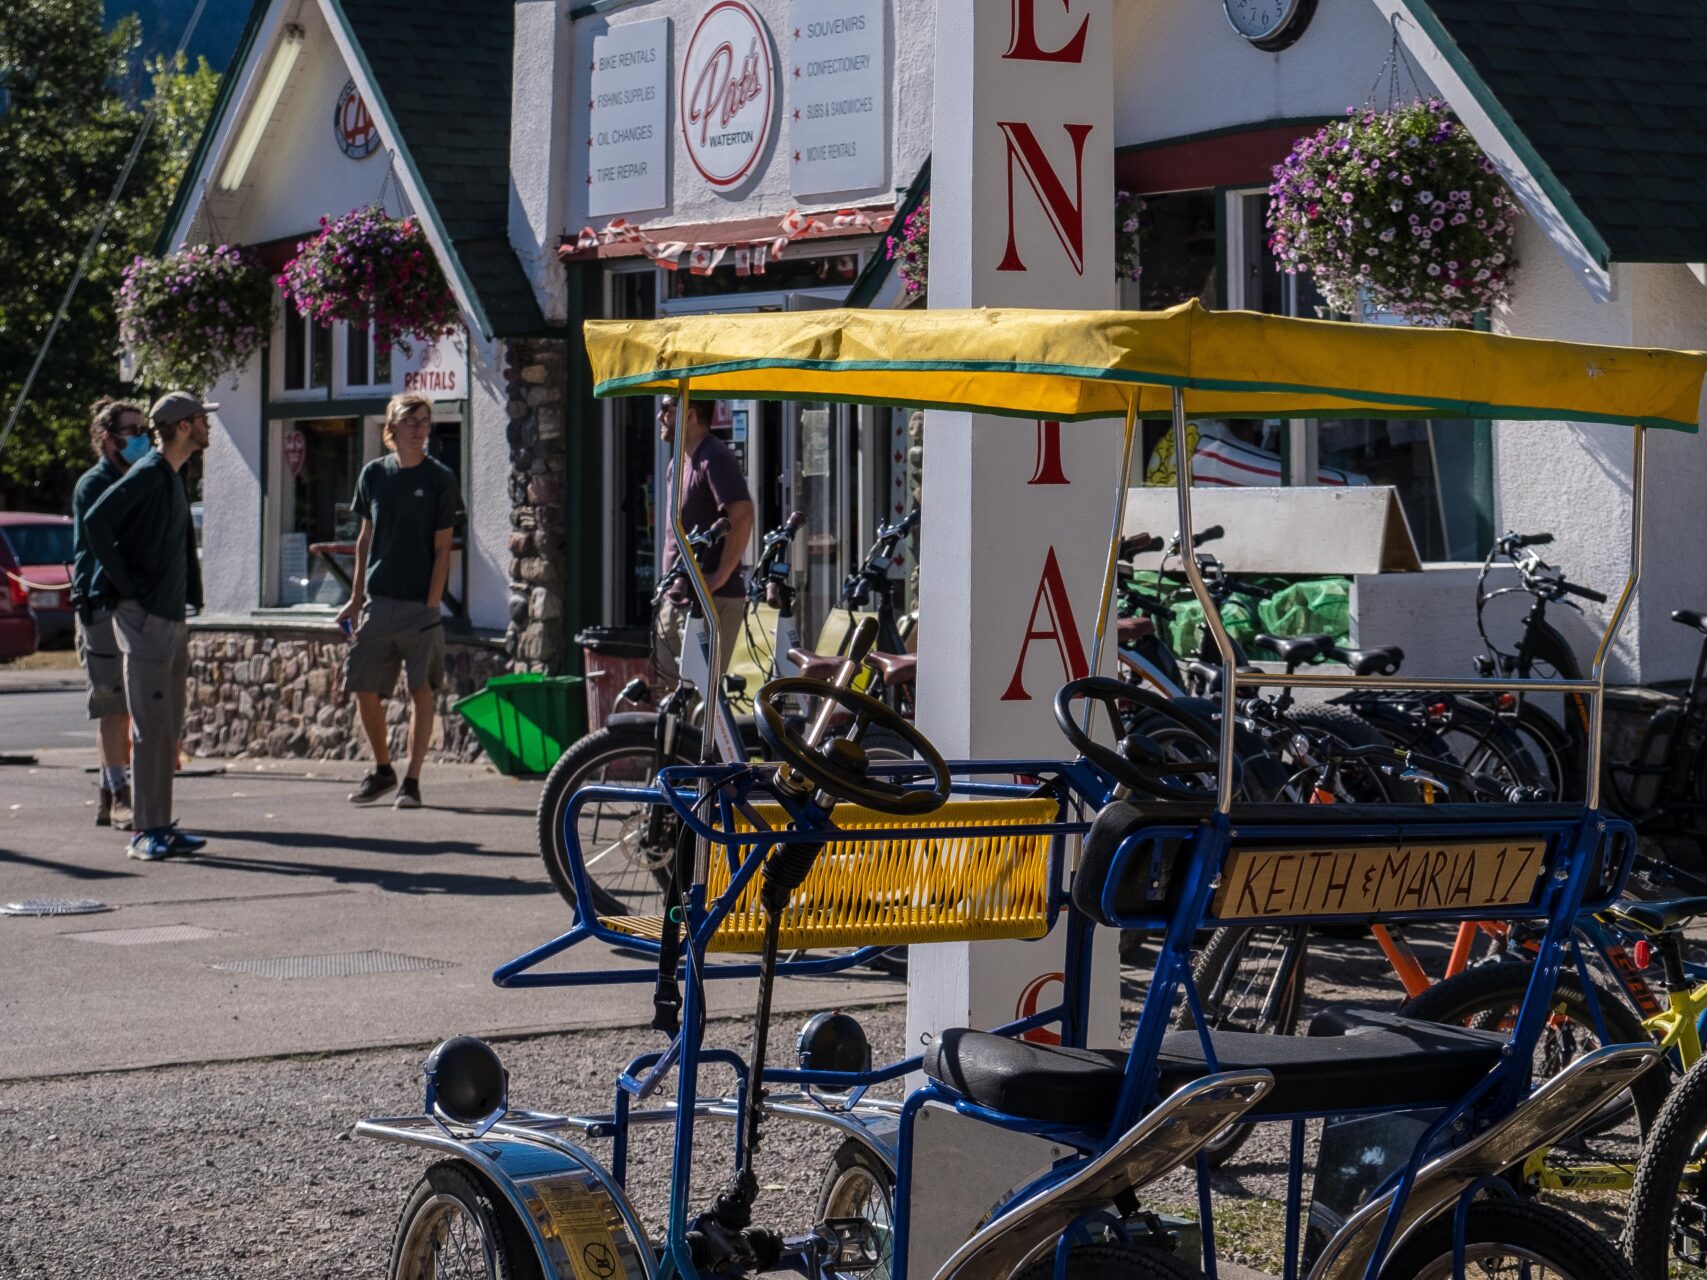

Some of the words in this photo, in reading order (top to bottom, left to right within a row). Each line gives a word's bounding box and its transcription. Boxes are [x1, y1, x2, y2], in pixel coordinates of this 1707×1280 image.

[807, 15, 865, 39] SOUVENIRS
[1261, 11, 1269, 25] 6
[599, 55, 617, 71] BIKE
[618, 48, 656, 67] RENTALS
[807, 53, 871, 77] CONFECTIONERY
[598, 91, 623, 108] FISHING
[623, 86, 656, 104] SUPPLIES
[689, 36, 762, 148] Pat's
[807, 103, 824, 120] SUBS
[825, 102, 830, 117] &
[831, 96, 873, 116] SANDWICHES
[597, 131, 610, 146] OIL
[612, 124, 653, 144] CHANGES
[709, 130, 754, 148] WATERTON
[807, 145, 827, 162] MOVIE
[828, 141, 856, 159] RENTALS
[597, 166, 615, 182] TIRE
[617, 161, 648, 179] REPAIR
[404, 370, 456, 391] RENTALS
[1236, 851, 1357, 915] KEITH
[1372, 848, 1476, 908] MARIA
[1483, 845, 1536, 904] 17
